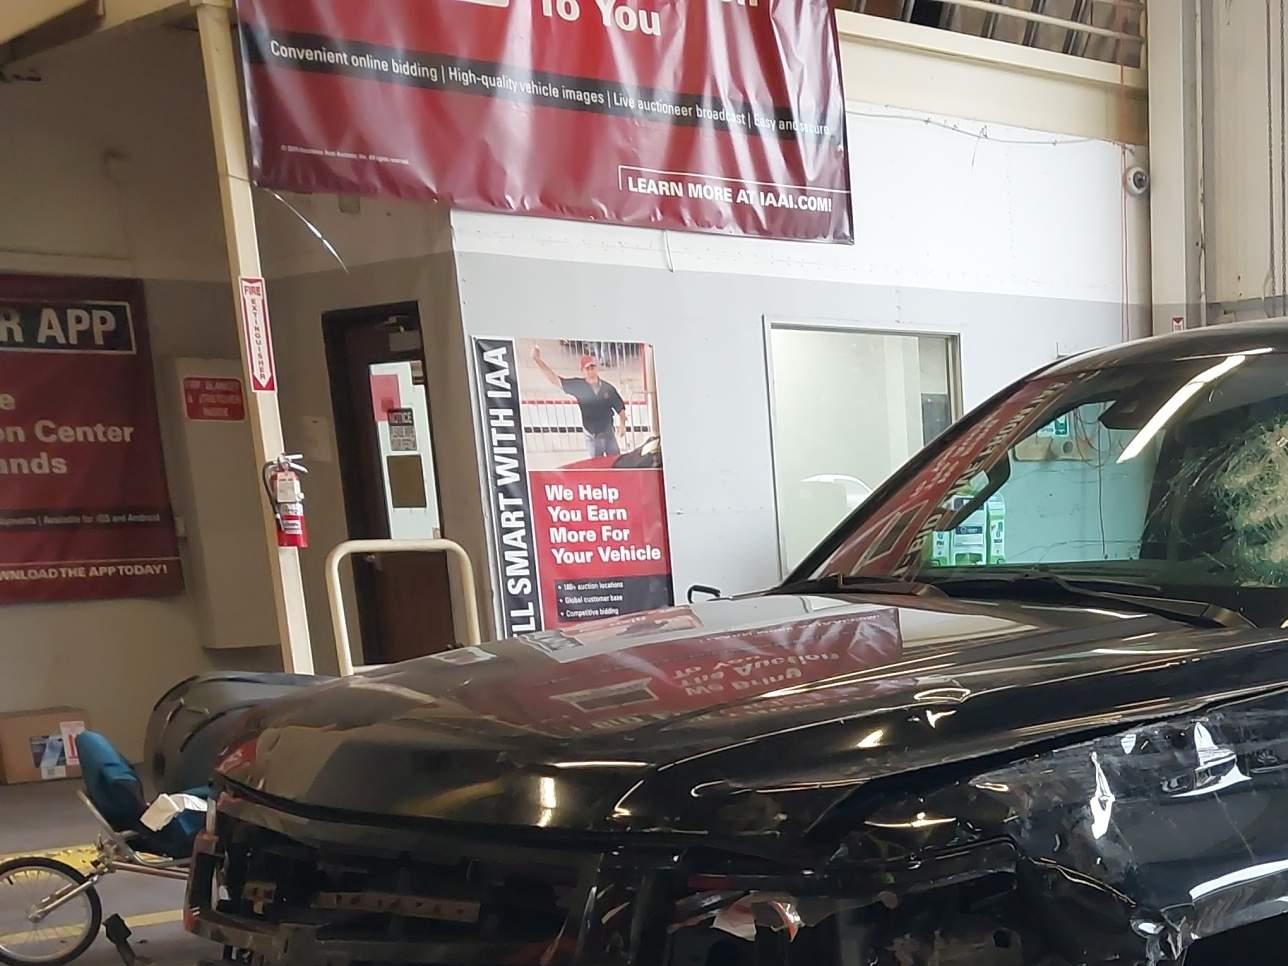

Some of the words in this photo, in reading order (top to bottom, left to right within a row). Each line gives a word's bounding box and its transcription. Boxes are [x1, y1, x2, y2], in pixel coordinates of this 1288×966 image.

[596, 0, 661, 36] You
[270, 40, 349, 65] Convenient
[351, 54, 389, 72] online
[392, 59, 438, 82] bidding
[448, 67, 518, 93] High-quality
[519, 80, 559, 98] vehicle
[562, 85, 605, 105] images
[614, 93, 635, 109] Live
[638, 98, 693, 118] auctioneer
[696, 106, 746, 125] broadcast
[754, 117, 776, 131] Easy
[779, 118, 798, 131] and
[628, 176, 683, 197] LEARN
[688, 183, 732, 202] MORE
[736, 191, 754, 204] AT
[759, 191, 832, 213] IAAI.COM!
[244, 285, 261, 297] FIRE
[37, 308, 116, 345] APP
[483, 346, 511, 398] IAA
[35, 419, 134, 443] Center
[489, 408, 520, 486] WITH
[545, 485, 573, 501] We
[578, 484, 619, 504] Help
[547, 505, 582, 522] You
[587, 504, 627, 521] Earn
[498, 492, 532, 595] SMART
[549, 527, 597, 543] More
[601, 525, 630, 542] For
[551, 547, 593, 564] Your
[597, 544, 661, 562] Vehicle
[59, 566, 86, 578] THE
[88, 565, 118, 577] APP
[118, 564, 168, 576] TODAY!
[564, 596, 583, 604] Global
[510, 602, 536, 638] LL
[566, 608, 599, 618] Competitive
[600, 607, 619, 616] bidding
